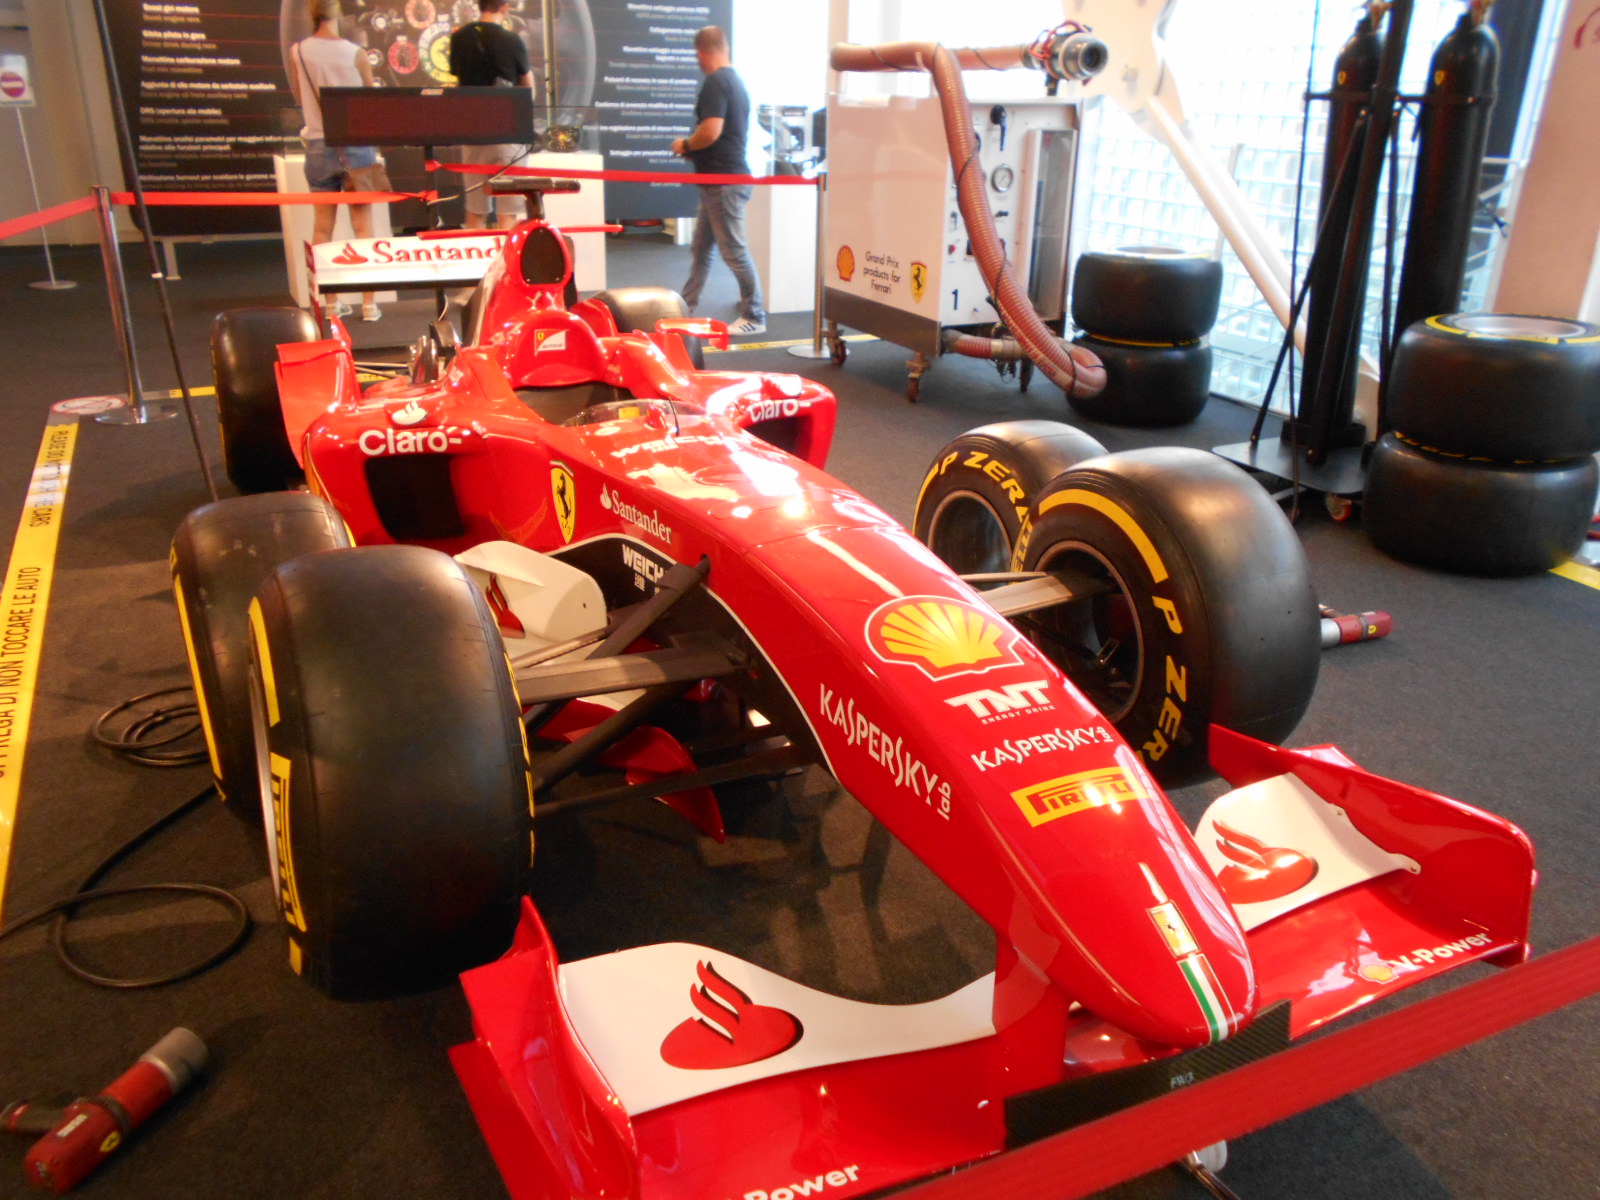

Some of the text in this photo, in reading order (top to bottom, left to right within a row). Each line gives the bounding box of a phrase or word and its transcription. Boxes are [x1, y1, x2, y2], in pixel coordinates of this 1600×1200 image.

[373, 236, 504, 264] Santand
[865, 250, 900, 269] Grand Prix
[863, 267, 901, 283] products for
[871, 279, 892, 294] Ferrari
[951, 289, 959, 311] 1
[359, 429, 449, 456] Claro
[612, 489, 672, 544] Santander
[622, 543, 665, 584] WEICH
[16, 566, 42, 592] AUTO
[13, 592, 36, 606] LE
[1, 608, 33, 659] TOCCARE
[943, 679, 1051, 719] TNT
[981, 704, 1056, 725] ENERGY DRINK
[819, 682, 952, 820] KASPERSKY lab
[971, 726, 1114, 772] KASPERSKY lab
[1388, 933, 1493, 971] V-Power
